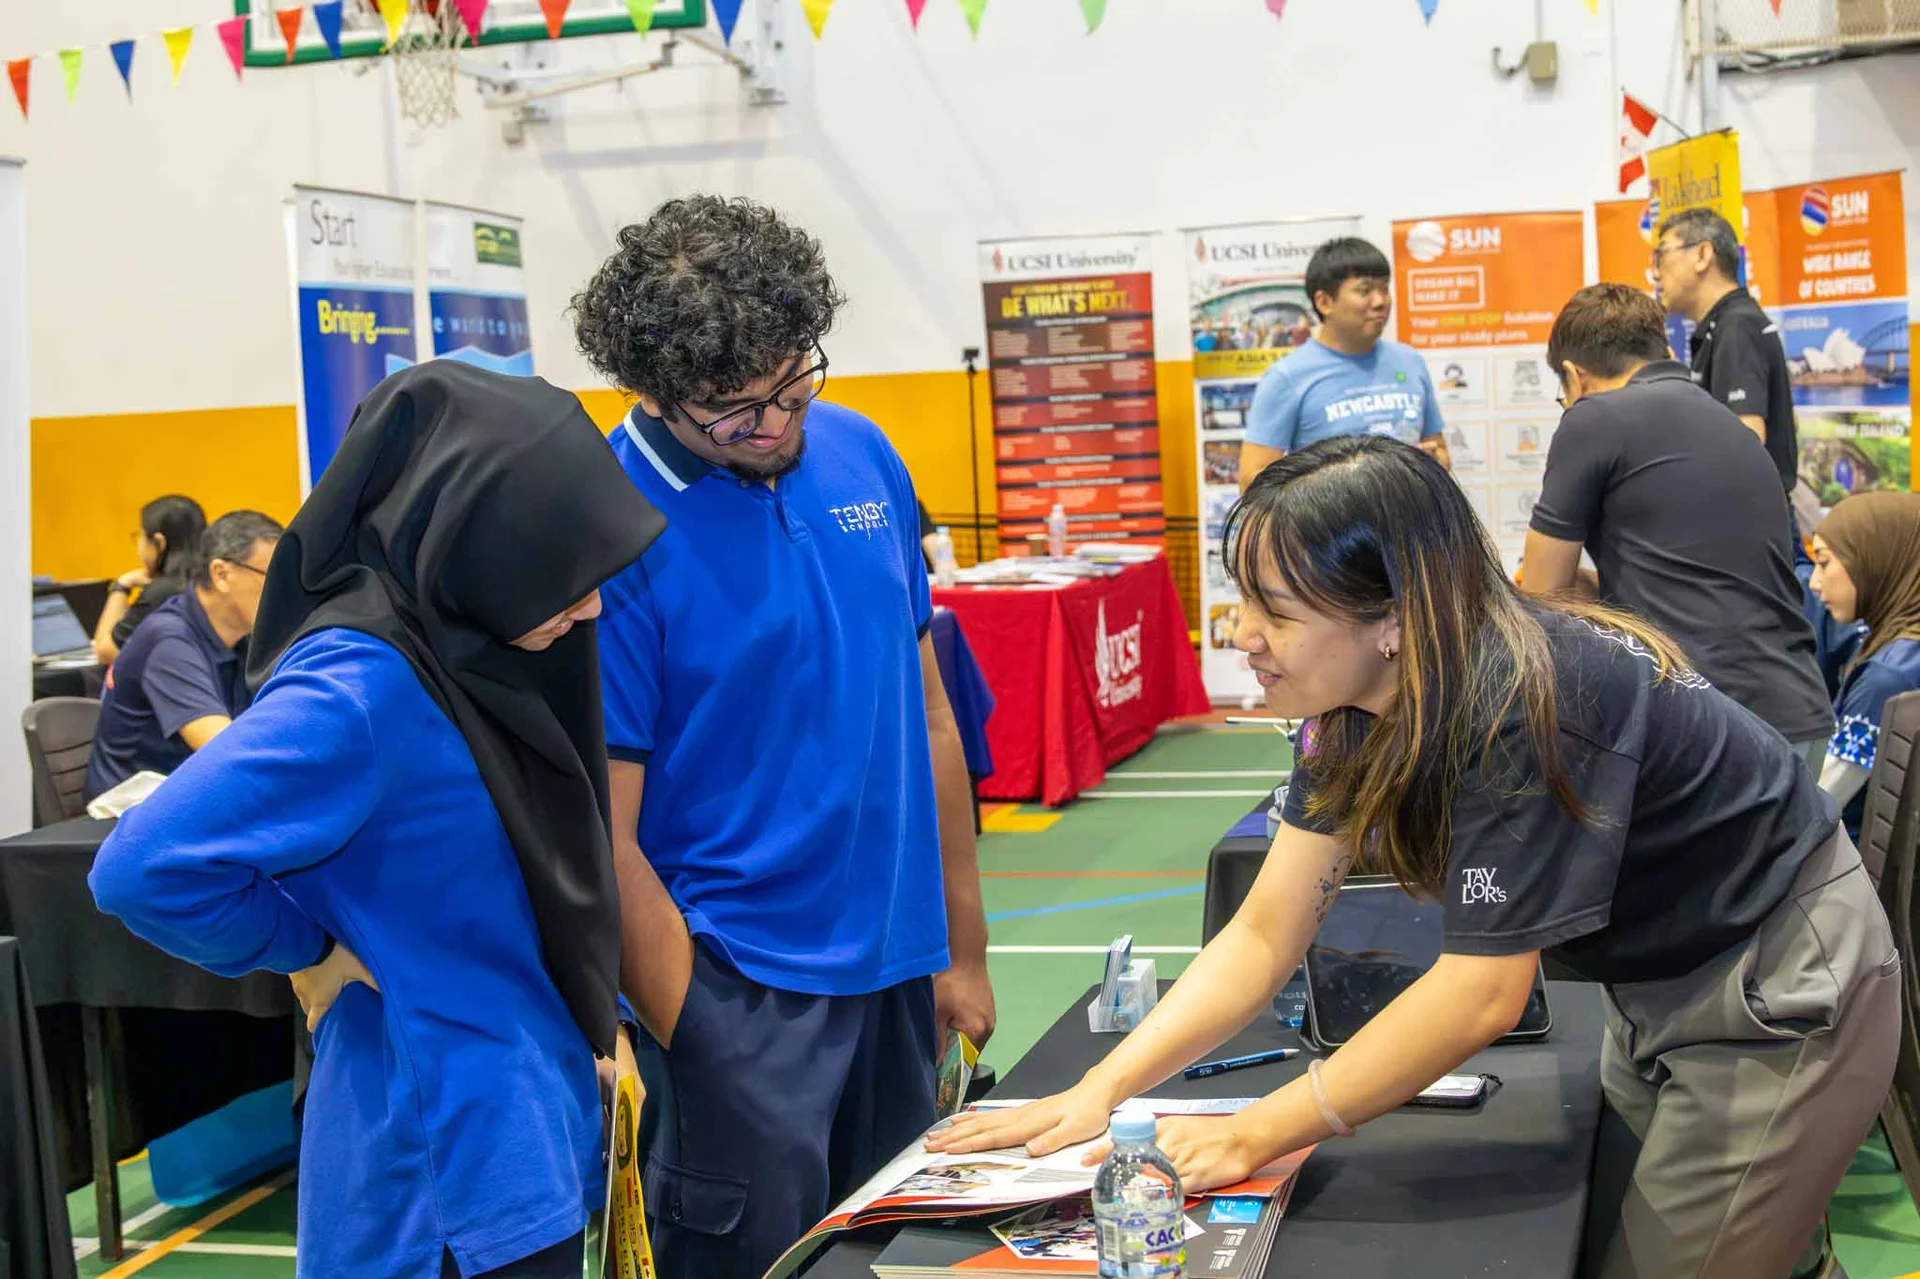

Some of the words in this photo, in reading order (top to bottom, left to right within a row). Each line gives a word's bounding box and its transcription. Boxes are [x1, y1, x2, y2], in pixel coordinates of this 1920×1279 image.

[1831, 191, 1868, 218] SUN
[310, 199, 357, 248] Start
[1451, 227, 1500, 249] SUN
[1008, 253, 1051, 271] UCSI
[1057, 249, 1136, 270] University
[1212, 244, 1258, 261] UCSI
[1002, 297, 1023, 318] BE
[1026, 291, 1086, 316] WHAT'S
[828, 502, 888, 526] TENBY
[1462, 867, 1497, 888] TAY
